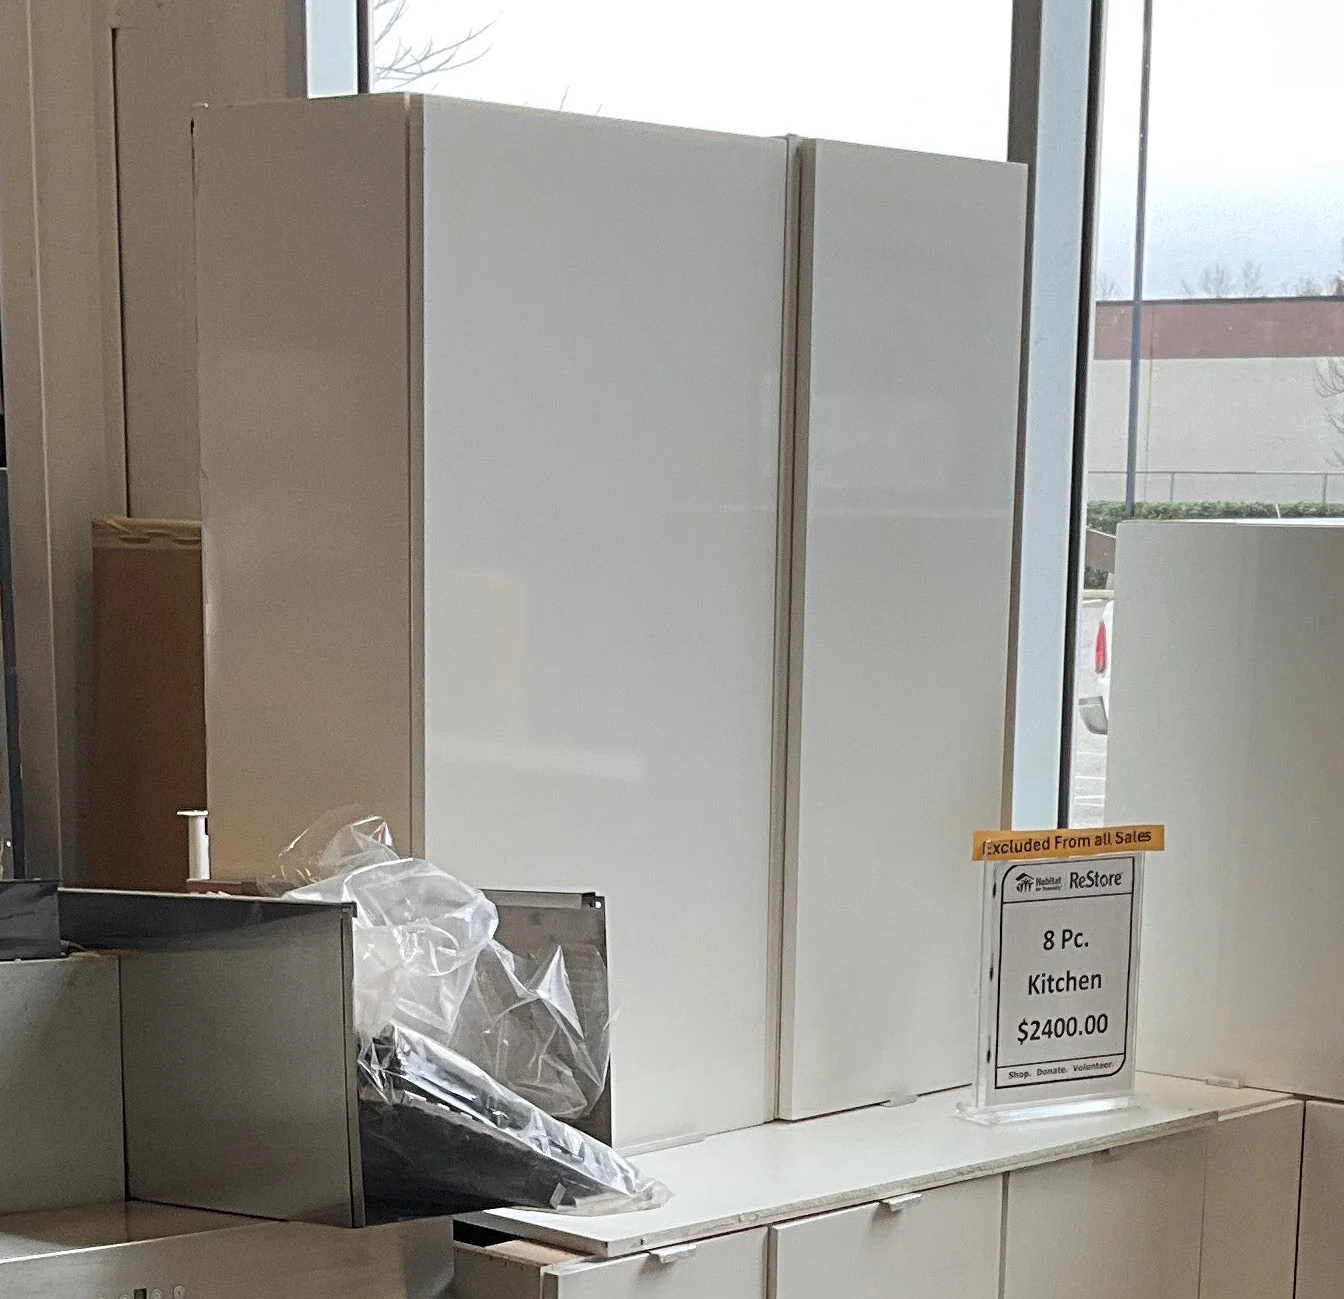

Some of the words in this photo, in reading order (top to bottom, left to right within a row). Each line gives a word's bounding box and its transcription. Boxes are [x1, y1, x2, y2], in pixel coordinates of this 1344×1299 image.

[981, 835, 1051, 856] Excluded
[1054, 833, 1091, 850] From
[1094, 831, 1112, 846] all
[1115, 829, 1152, 844] Sales
[1036, 876, 1061, 886] Habitat
[1069, 870, 1122, 890] ReStore
[1043, 930, 1054, 951] 8
[1061, 929, 1089, 950] Pc.
[1027, 970, 1102, 996] Kitchen
[1017, 1013, 1108, 1045] $2400.00
[1008, 1070, 1031, 1080] Shop.
[1036, 1066, 1069, 1077] Donate.
[1072, 1061, 1114, 1072] Volunteer.
